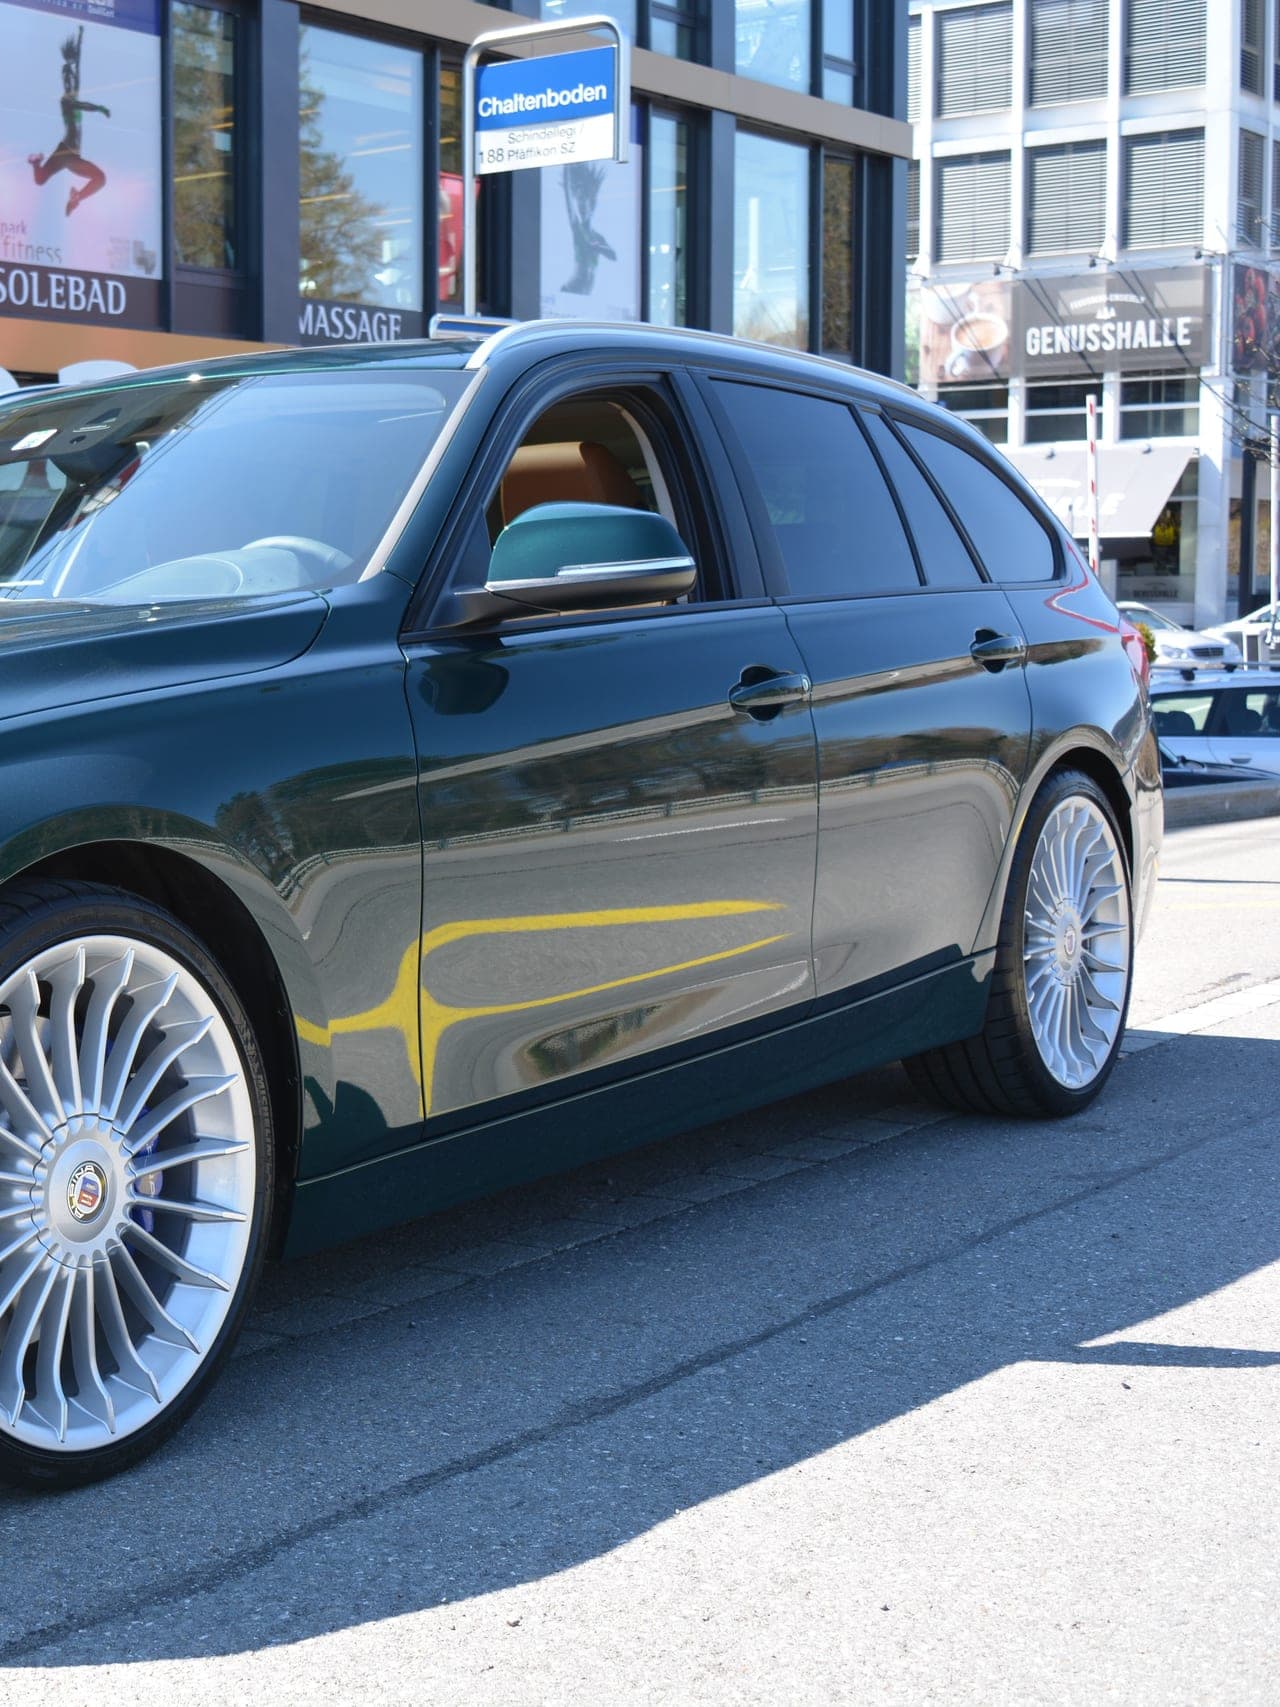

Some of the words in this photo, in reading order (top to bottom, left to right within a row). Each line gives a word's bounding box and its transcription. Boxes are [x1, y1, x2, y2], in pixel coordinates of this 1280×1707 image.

[478, 83, 607, 117] Chaltenboden
[479, 148, 504, 164] 188
[561, 142, 576, 155] SZ
[3, 235, 63, 264] fitness
[298, 303, 401, 343] MASSAGE
[1026, 317, 1192, 356] GENUSSHALLE
